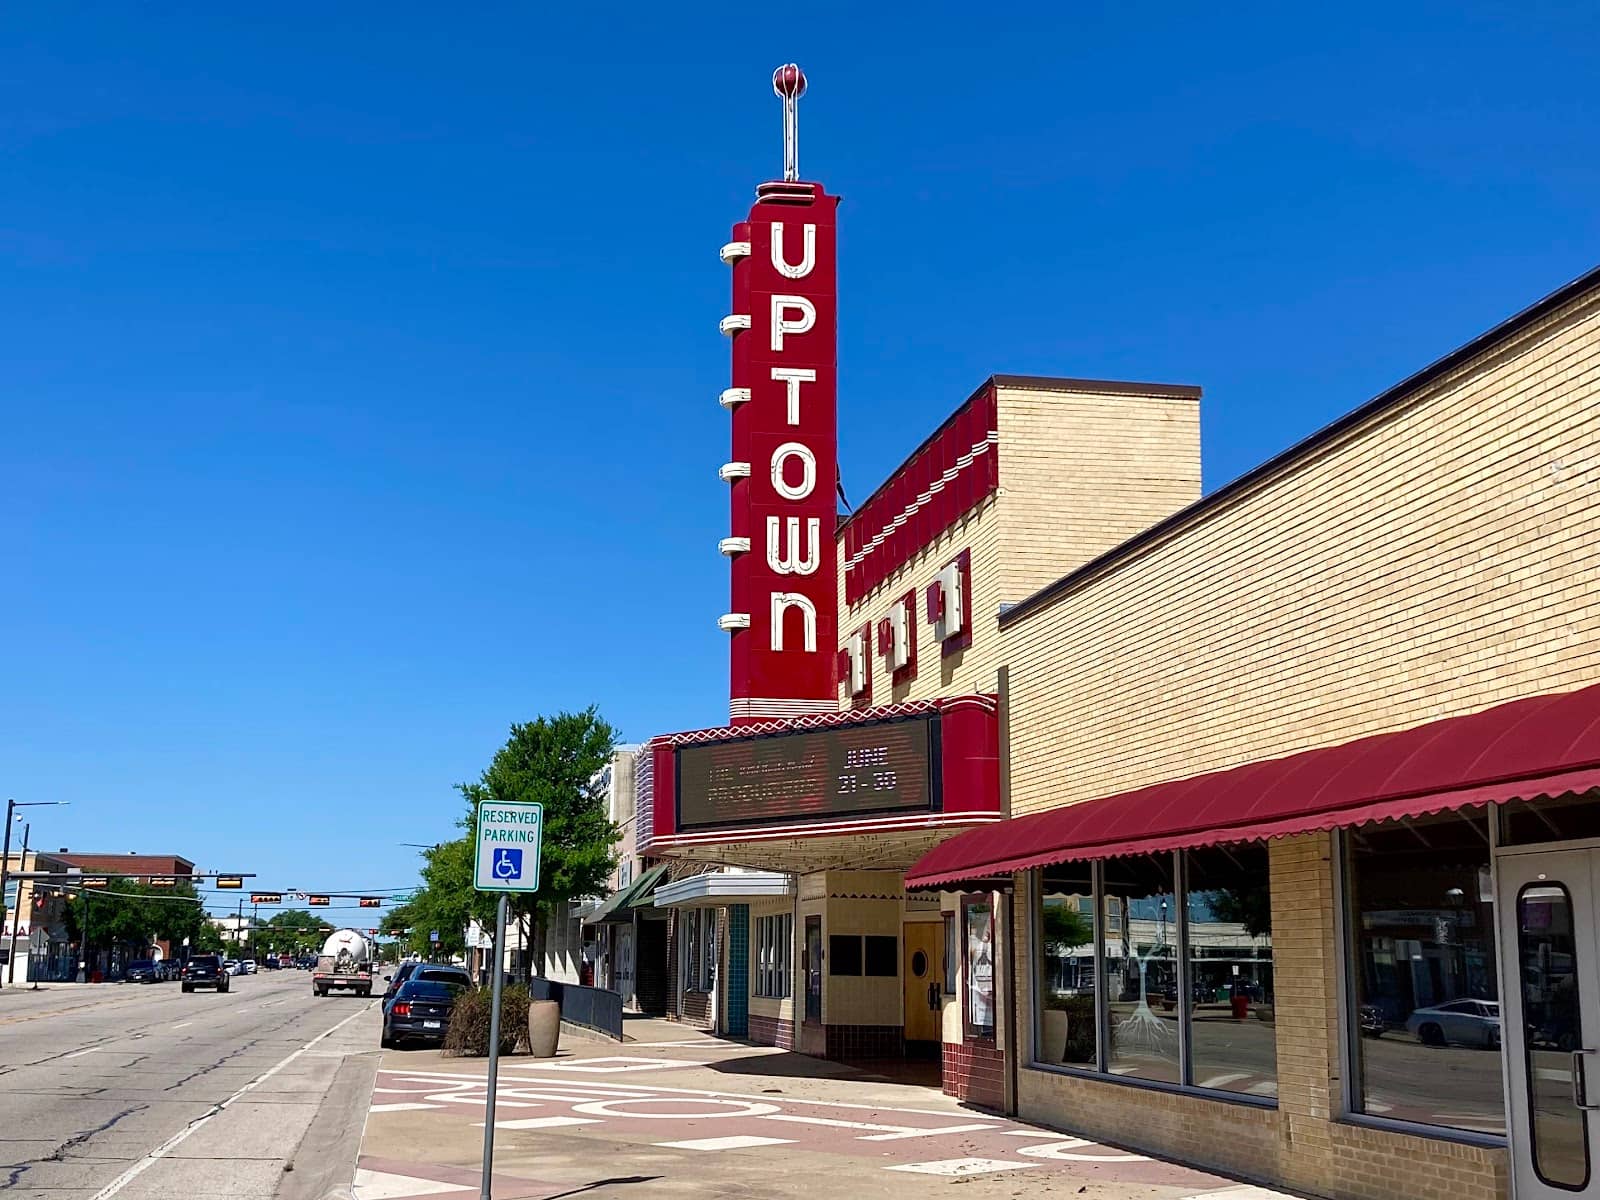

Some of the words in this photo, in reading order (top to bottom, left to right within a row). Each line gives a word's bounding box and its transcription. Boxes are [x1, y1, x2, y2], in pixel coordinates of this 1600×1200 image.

[842, 747, 889, 769] JUNE
[482, 810, 538, 824] RESERVED
[484, 829, 534, 843] PARKING
